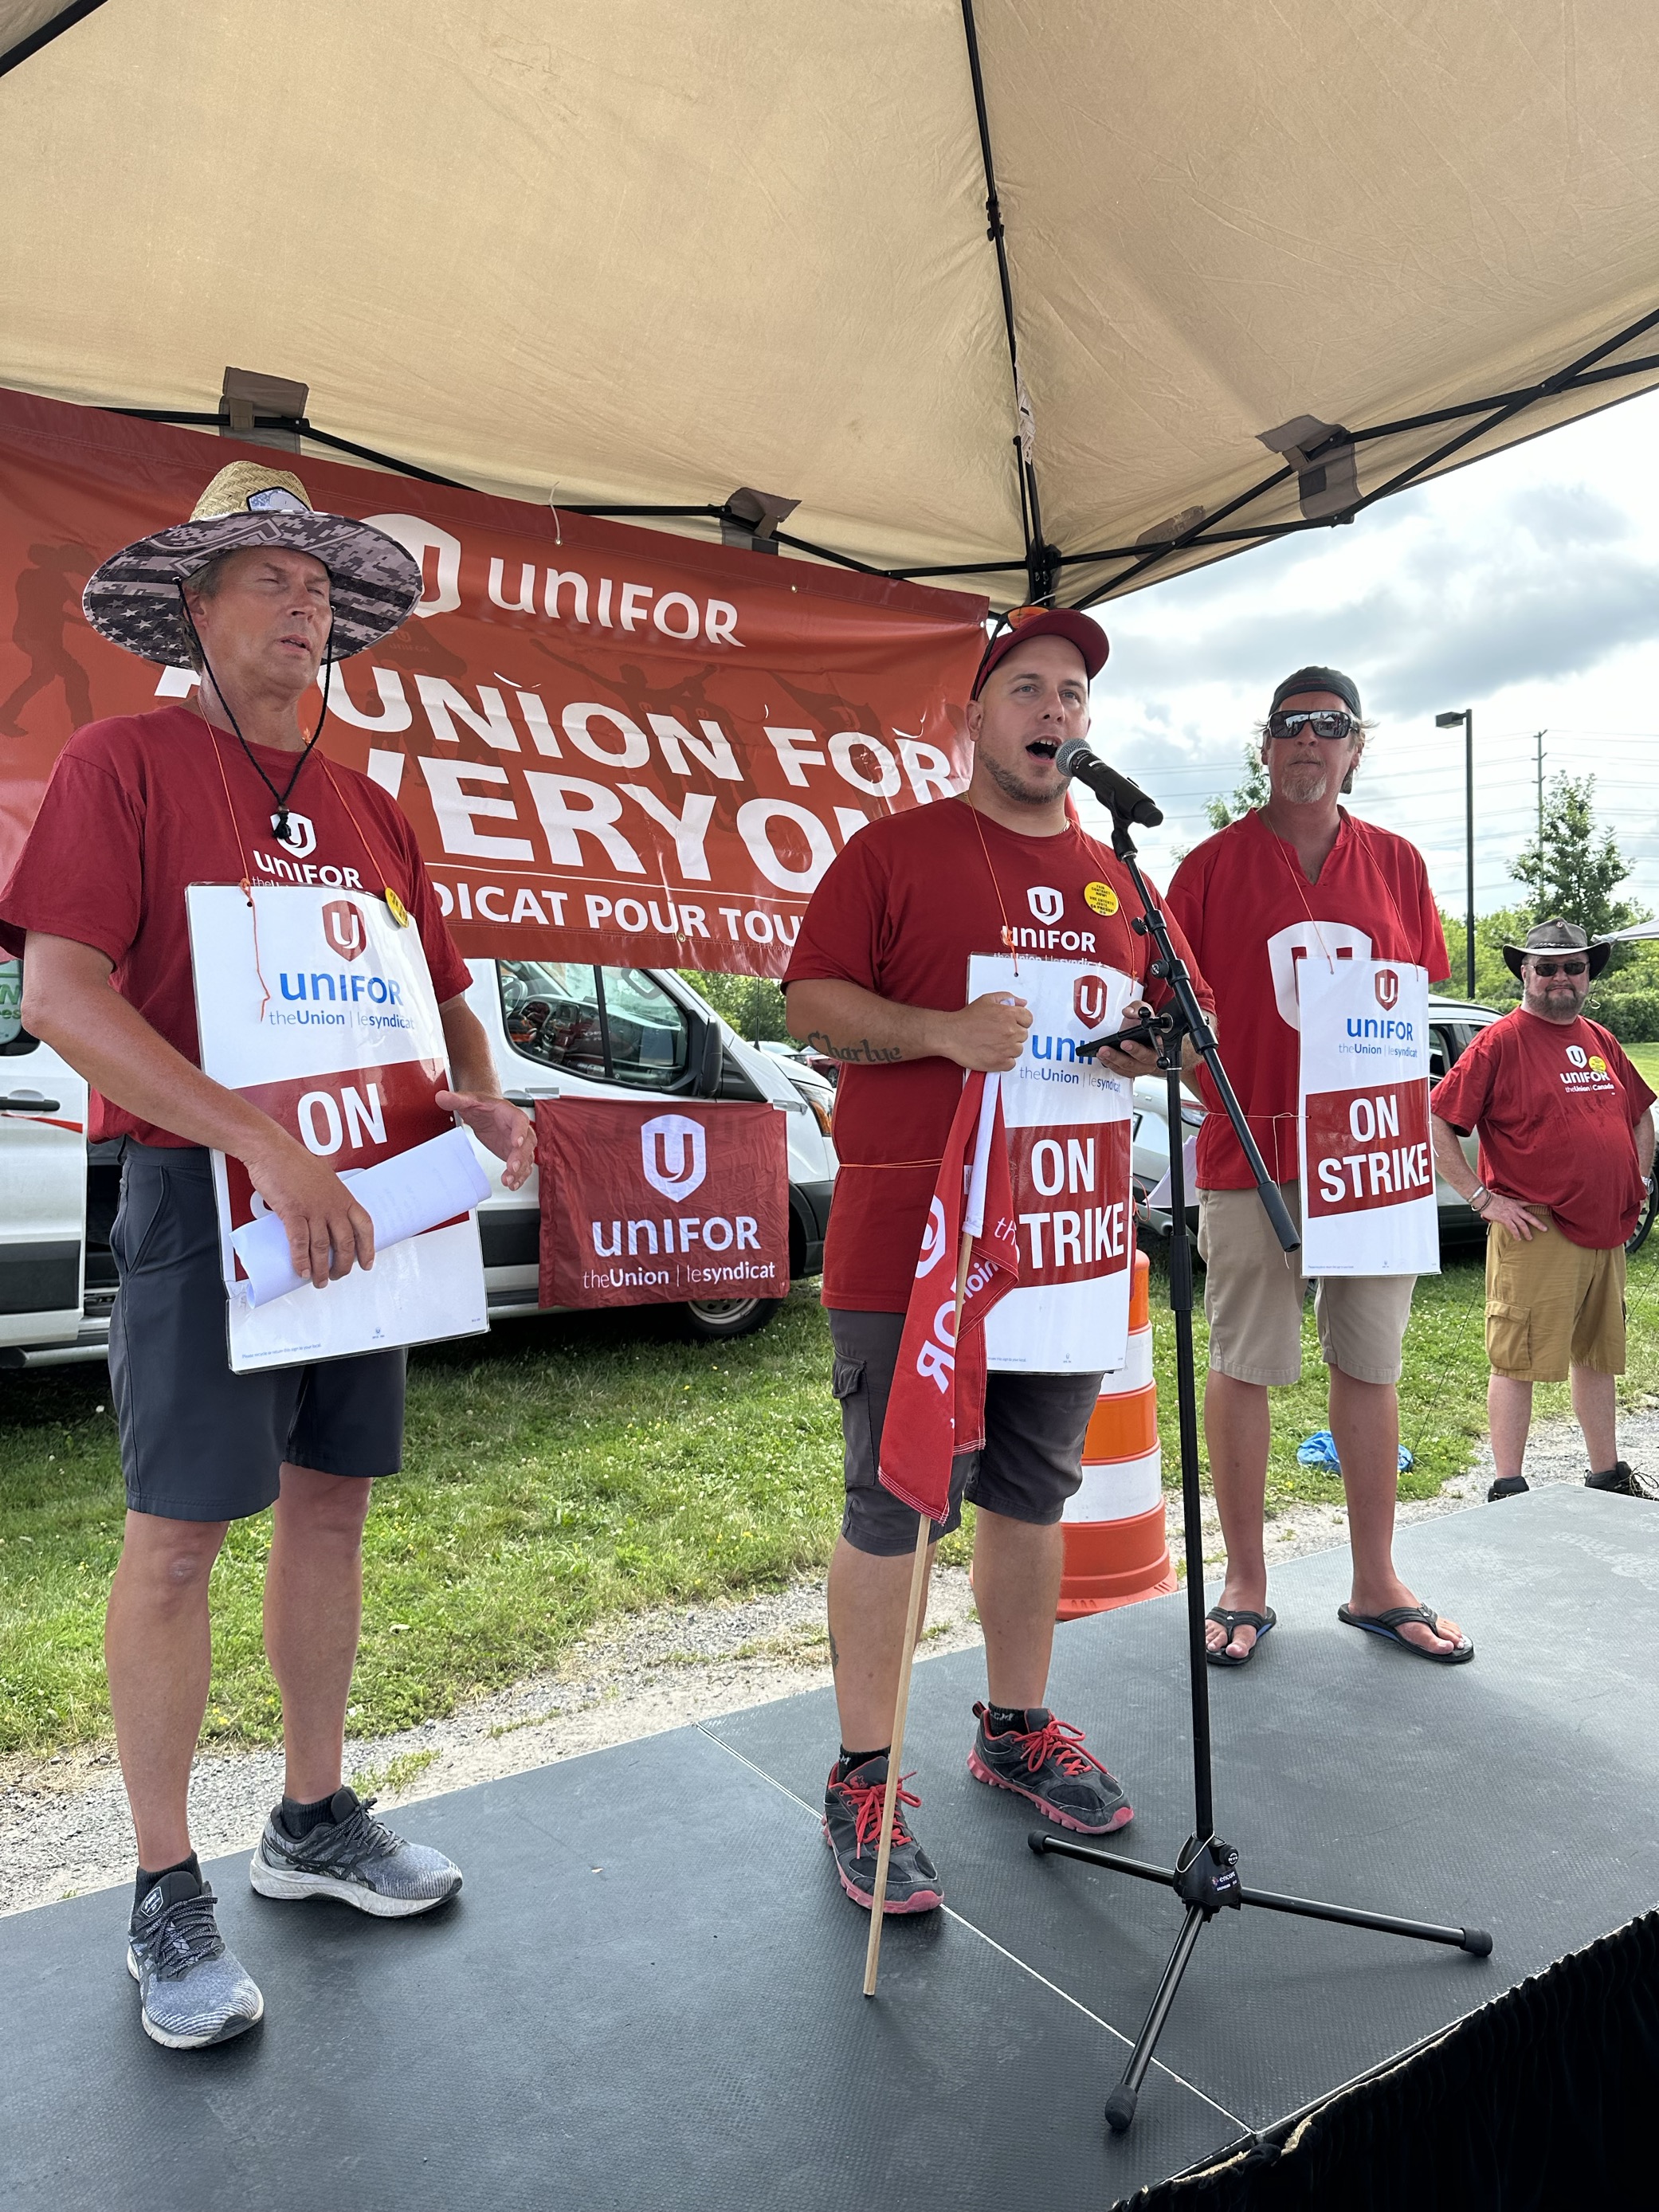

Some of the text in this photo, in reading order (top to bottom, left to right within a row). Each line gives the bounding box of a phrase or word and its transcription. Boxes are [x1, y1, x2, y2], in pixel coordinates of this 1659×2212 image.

[763, 726, 958, 805] FOR
[367, 749, 871, 894] ERYO
[584, 893, 711, 939] POUR
[718, 907, 804, 947] TOU
[297, 1083, 387, 1156] ON
[1350, 1095, 1398, 1142] ON
[1030, 1138, 1095, 1197] ON
[1317, 1142, 1431, 1203] STRIKE
[1016, 1202, 1125, 1270] TRIKE
